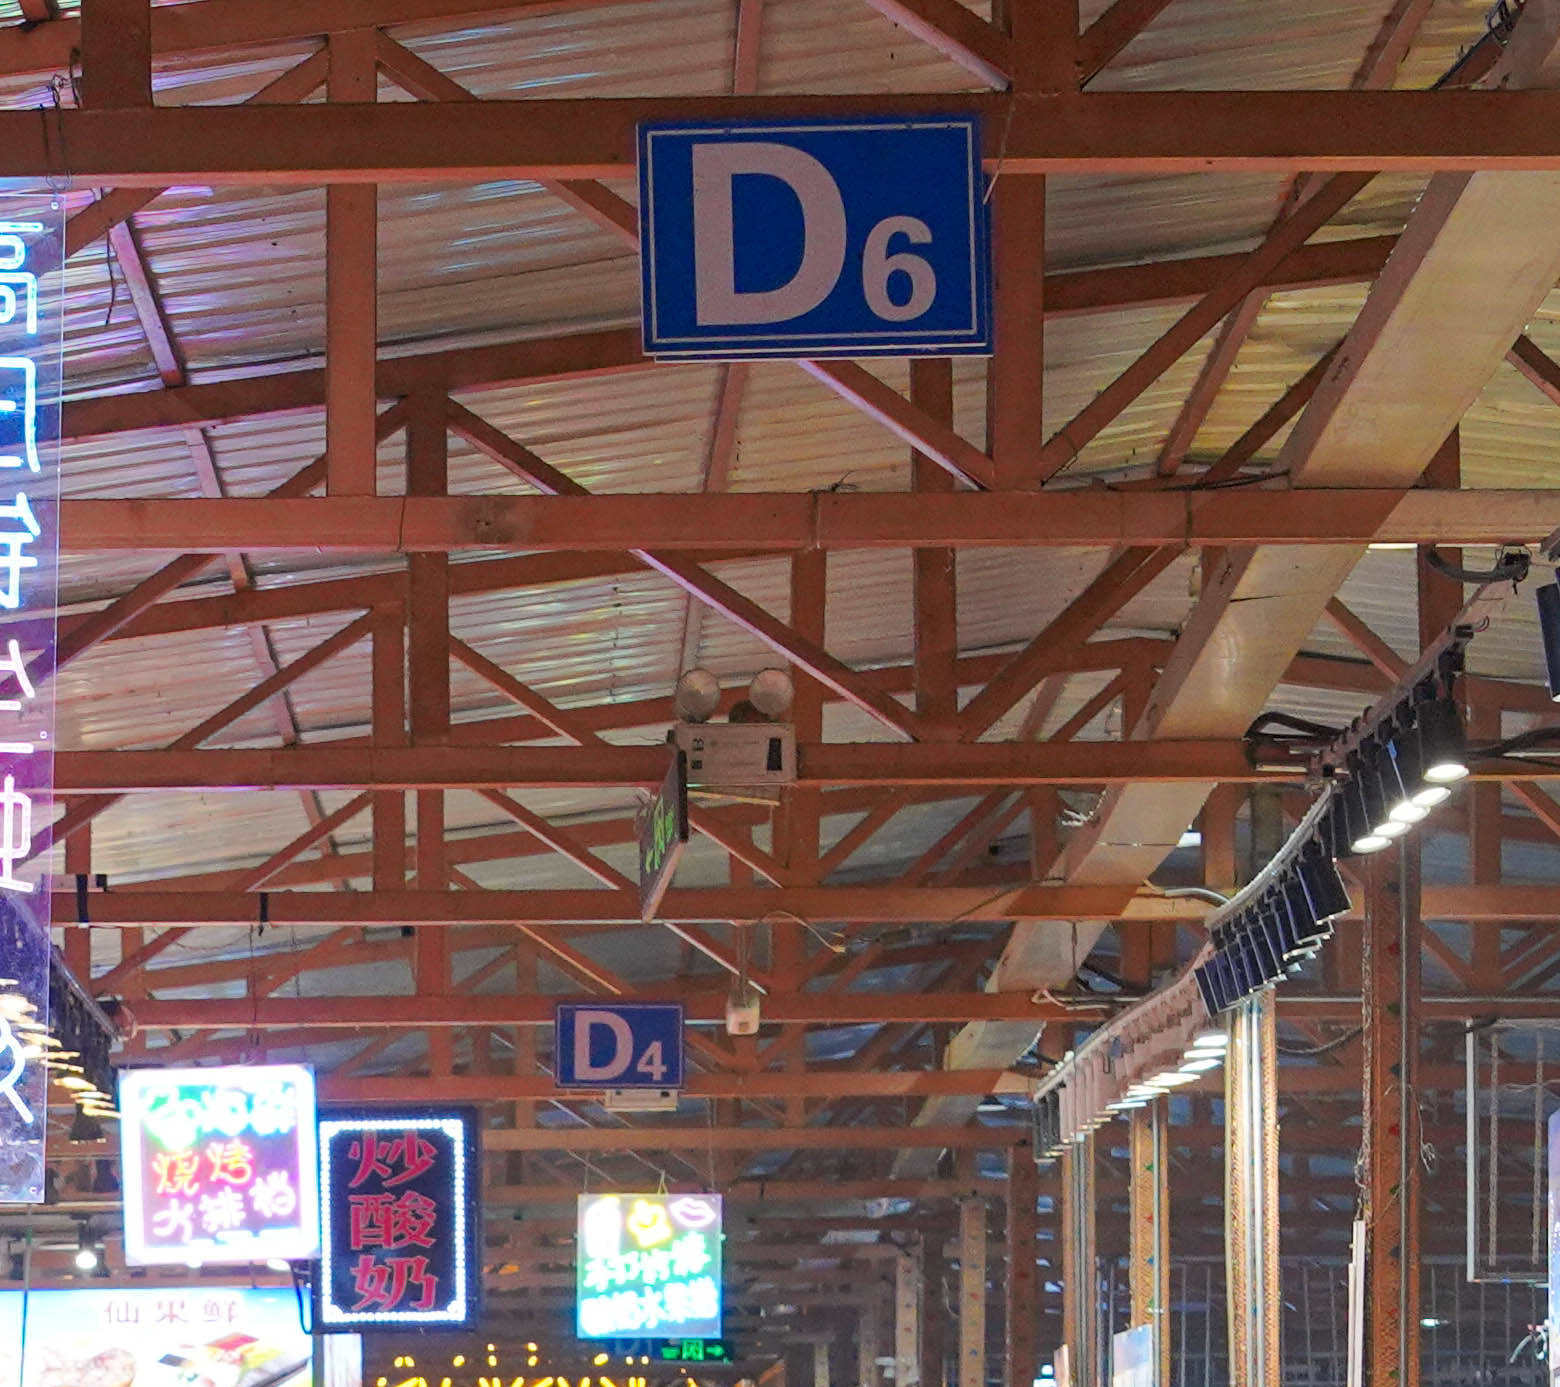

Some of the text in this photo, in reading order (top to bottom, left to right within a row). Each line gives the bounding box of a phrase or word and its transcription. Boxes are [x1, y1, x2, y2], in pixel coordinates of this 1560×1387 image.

[692, 141, 937, 326] D6
[573, 1008, 669, 1081] D4
[150, 1137, 255, 1196] 烧烤
[348, 1129, 438, 1311] 炒酸奶
